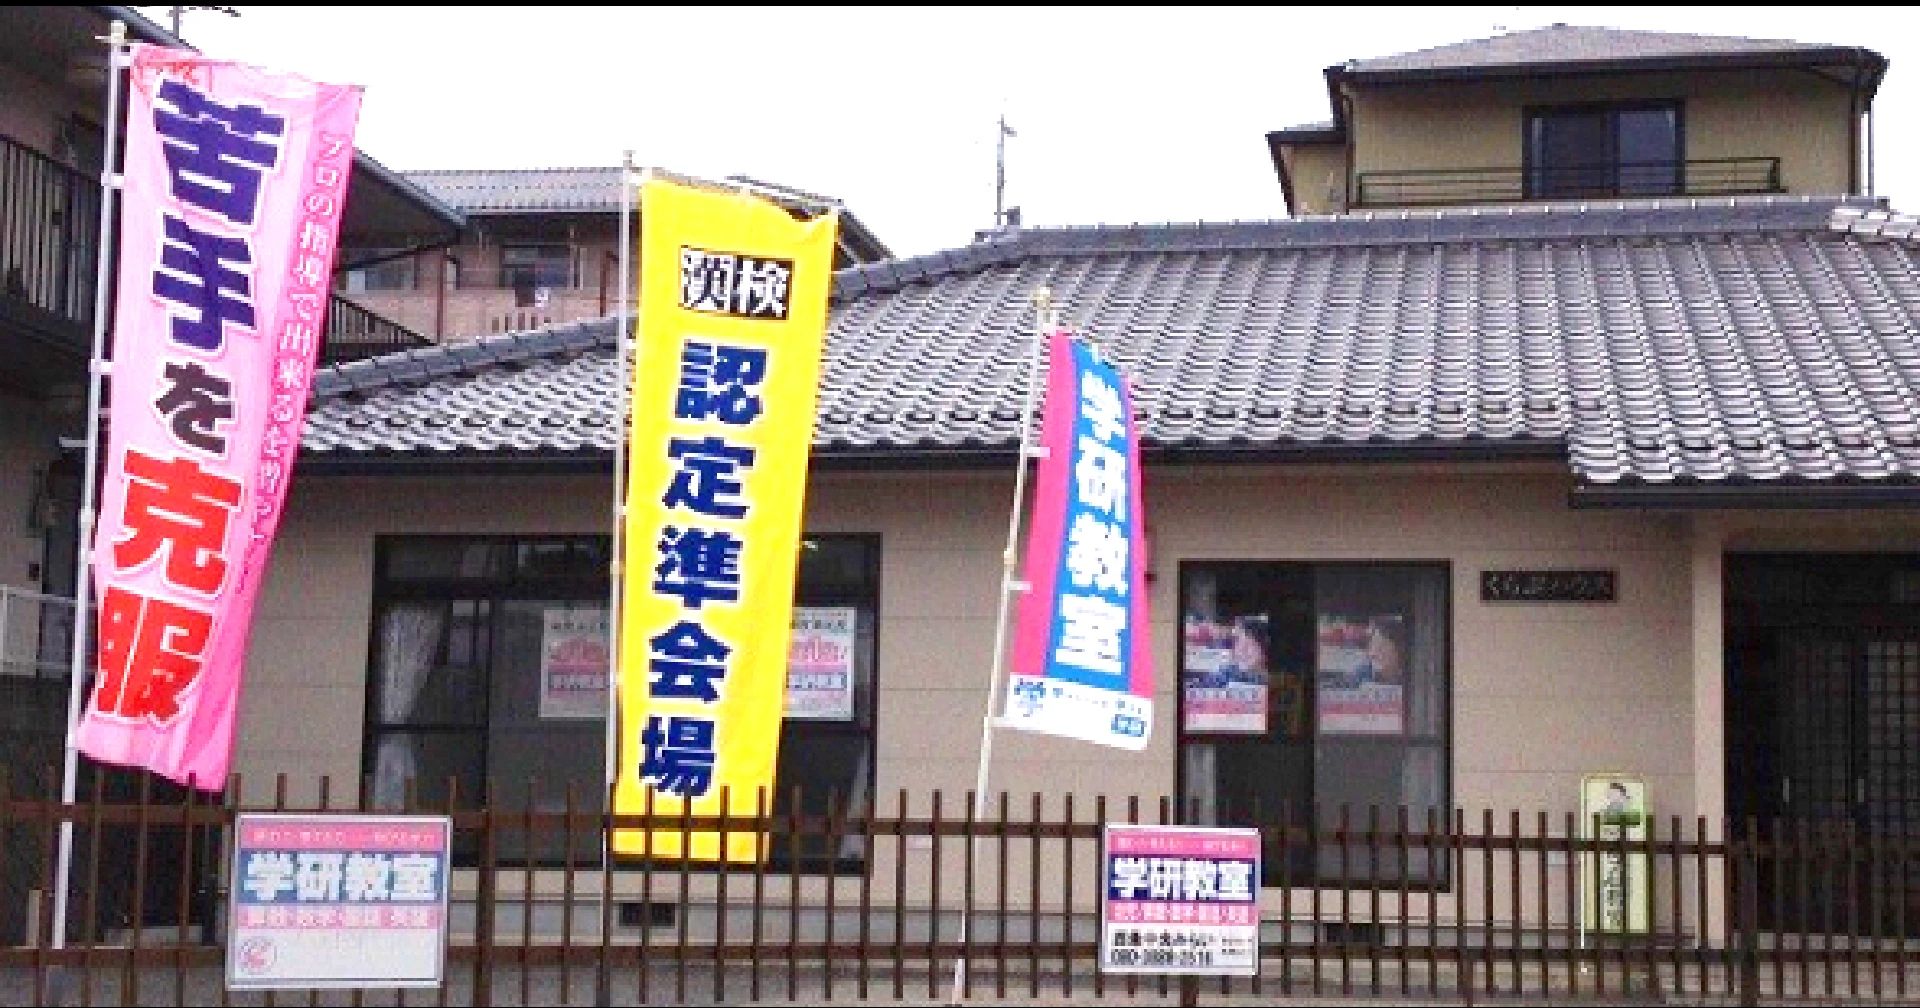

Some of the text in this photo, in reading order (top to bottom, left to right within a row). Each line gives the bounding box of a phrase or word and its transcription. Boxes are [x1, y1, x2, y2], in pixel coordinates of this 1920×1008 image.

[679, 247, 794, 320] 漢検
[97, 79, 285, 722] 苦手を克服
[640, 339, 768, 797] 認定準会場
[1054, 368, 1129, 675] 学研教室
[243, 853, 438, 901] 学研教室
[1111, 857, 1253, 901] 学研教室
